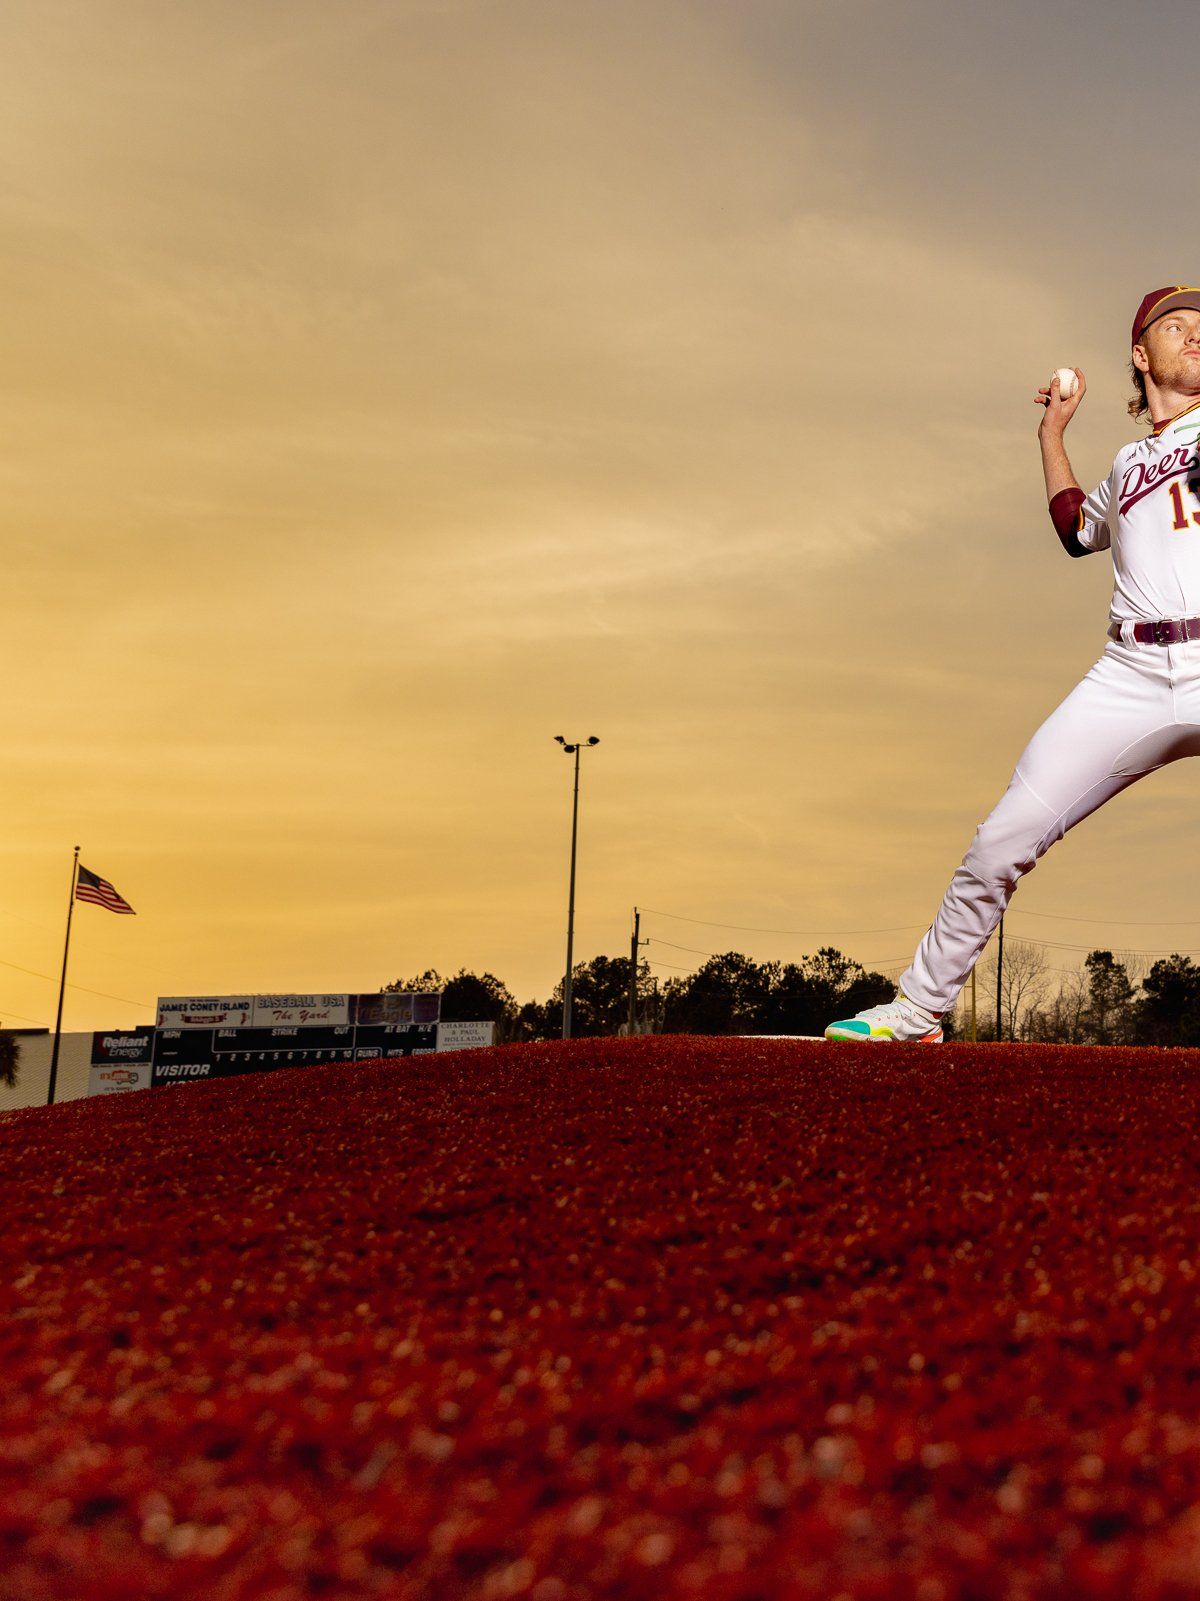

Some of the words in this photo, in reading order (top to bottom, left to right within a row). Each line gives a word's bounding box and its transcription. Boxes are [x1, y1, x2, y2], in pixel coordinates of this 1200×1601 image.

[1119, 448, 1200, 502] Deer
[160, 1003, 187, 1012] JAMES
[190, 1002, 219, 1011] CONEY
[220, 1001, 250, 1010] ISLAND
[258, 996, 316, 1008] BASEBALL
[320, 996, 344, 1007] USA
[273, 1010, 292, 1020] The
[299, 1010, 330, 1023] Yard
[218, 1029, 237, 1037] BALL
[271, 1028, 298, 1036] STRIKE
[333, 1027, 349, 1035] OUT
[384, 1025, 394, 1033] AT
[396, 1025, 411, 1033] BAT
[102, 1036, 149, 1048] Reliant
[109, 1047, 143, 1058] Energy
[215, 1054, 221, 1062] 1
[230, 1053, 237, 1061] 2
[244, 1053, 251, 1061] 3
[273, 1052, 280, 1060] 5
[287, 1052, 294, 1060] 6
[302, 1051, 308, 1059] 7
[316, 1051, 322, 1059] 8
[330, 1050, 336, 1058] 9
[342, 1050, 352, 1058] 10
[155, 1064, 211, 1077] VISITOR
